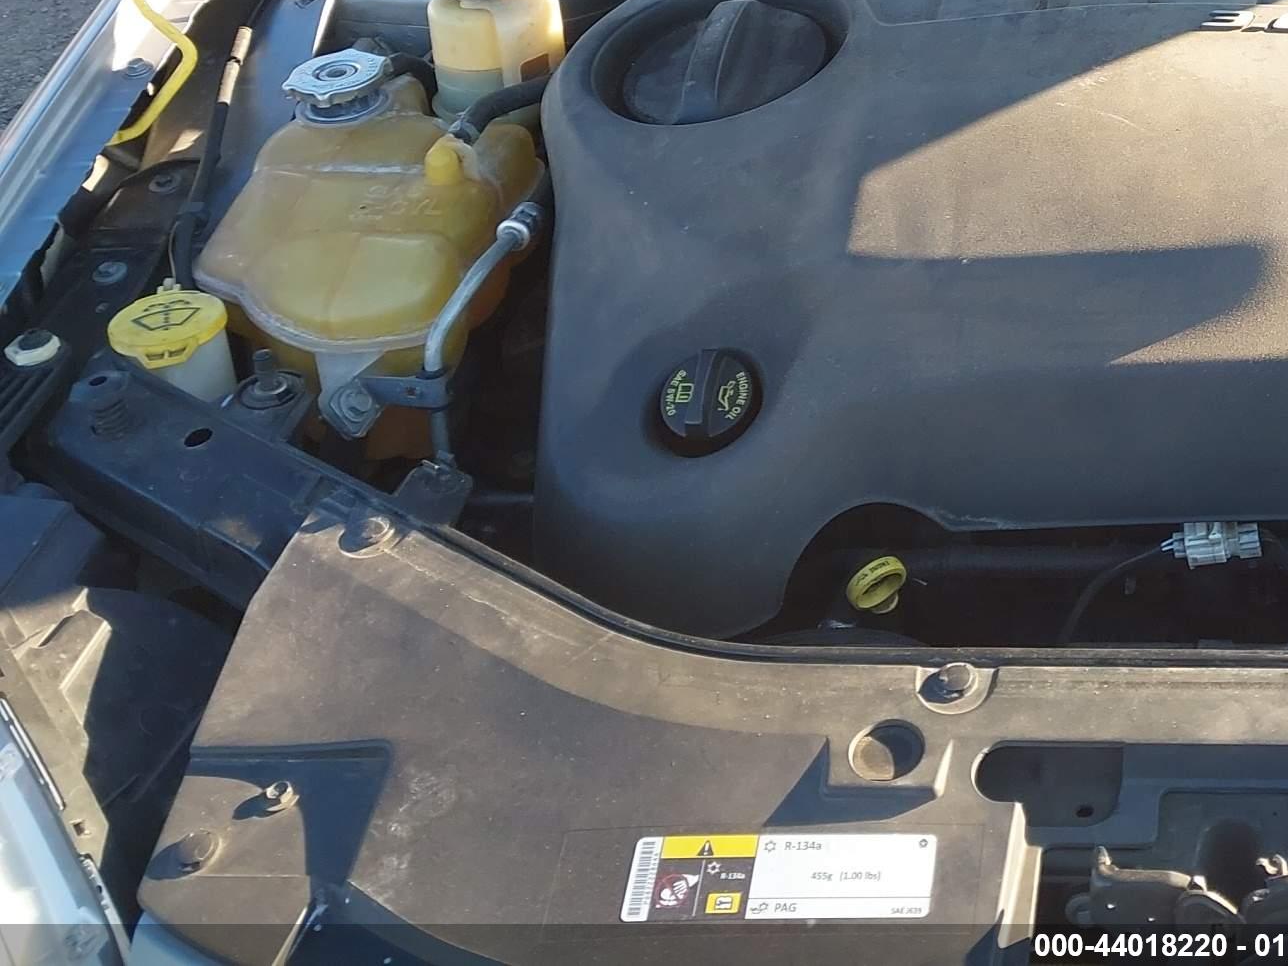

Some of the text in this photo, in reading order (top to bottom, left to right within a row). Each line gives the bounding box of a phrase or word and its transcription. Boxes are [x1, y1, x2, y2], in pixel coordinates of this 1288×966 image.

[670, 369, 687, 387] SAE
[725, 371, 749, 420] ENGINE OIL
[784, 841, 822, 851] R-134a
[811, 871, 882, 882] 455g (1.00 lbs)
[774, 903, 797, 913] PAG
